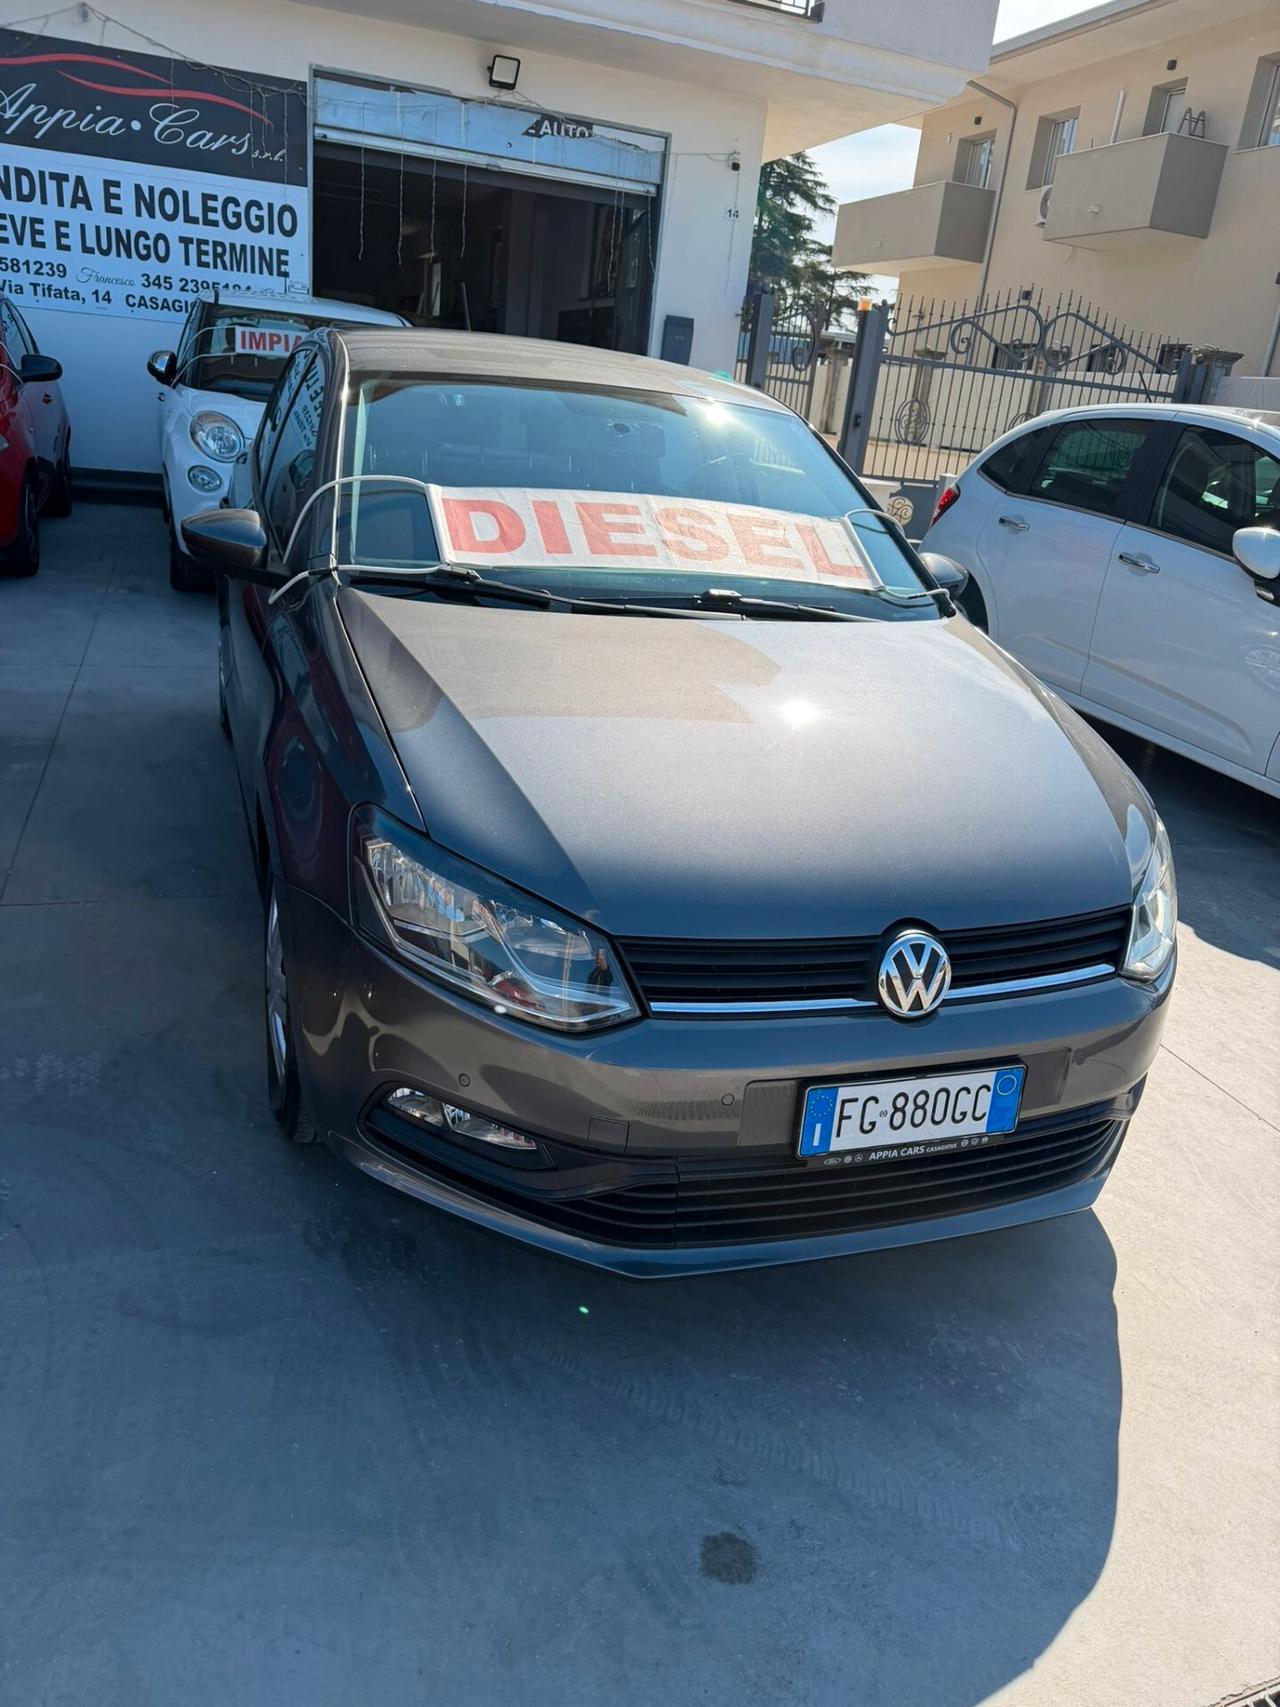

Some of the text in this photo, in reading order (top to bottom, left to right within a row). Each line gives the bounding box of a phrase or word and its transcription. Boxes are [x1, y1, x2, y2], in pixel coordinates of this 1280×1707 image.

[103, 178, 123, 215] E
[134, 183, 298, 238] NOLEGGIO
[726, 209, 740, 219] 14
[55, 219, 72, 252] E
[80, 222, 171, 264] LUNGO
[178, 235, 290, 279] TERMINE
[0, 257, 67, 279] 581239
[141, 272, 173, 291] 345
[29, 282, 86, 305] Tifata,
[92, 289, 112, 305] 14
[125, 293, 190, 314] CASAGI
[441, 497, 870, 580] DIESEL
[868, 1149, 898, 1161] APPIA
[900, 1145, 925, 1157] CARS
